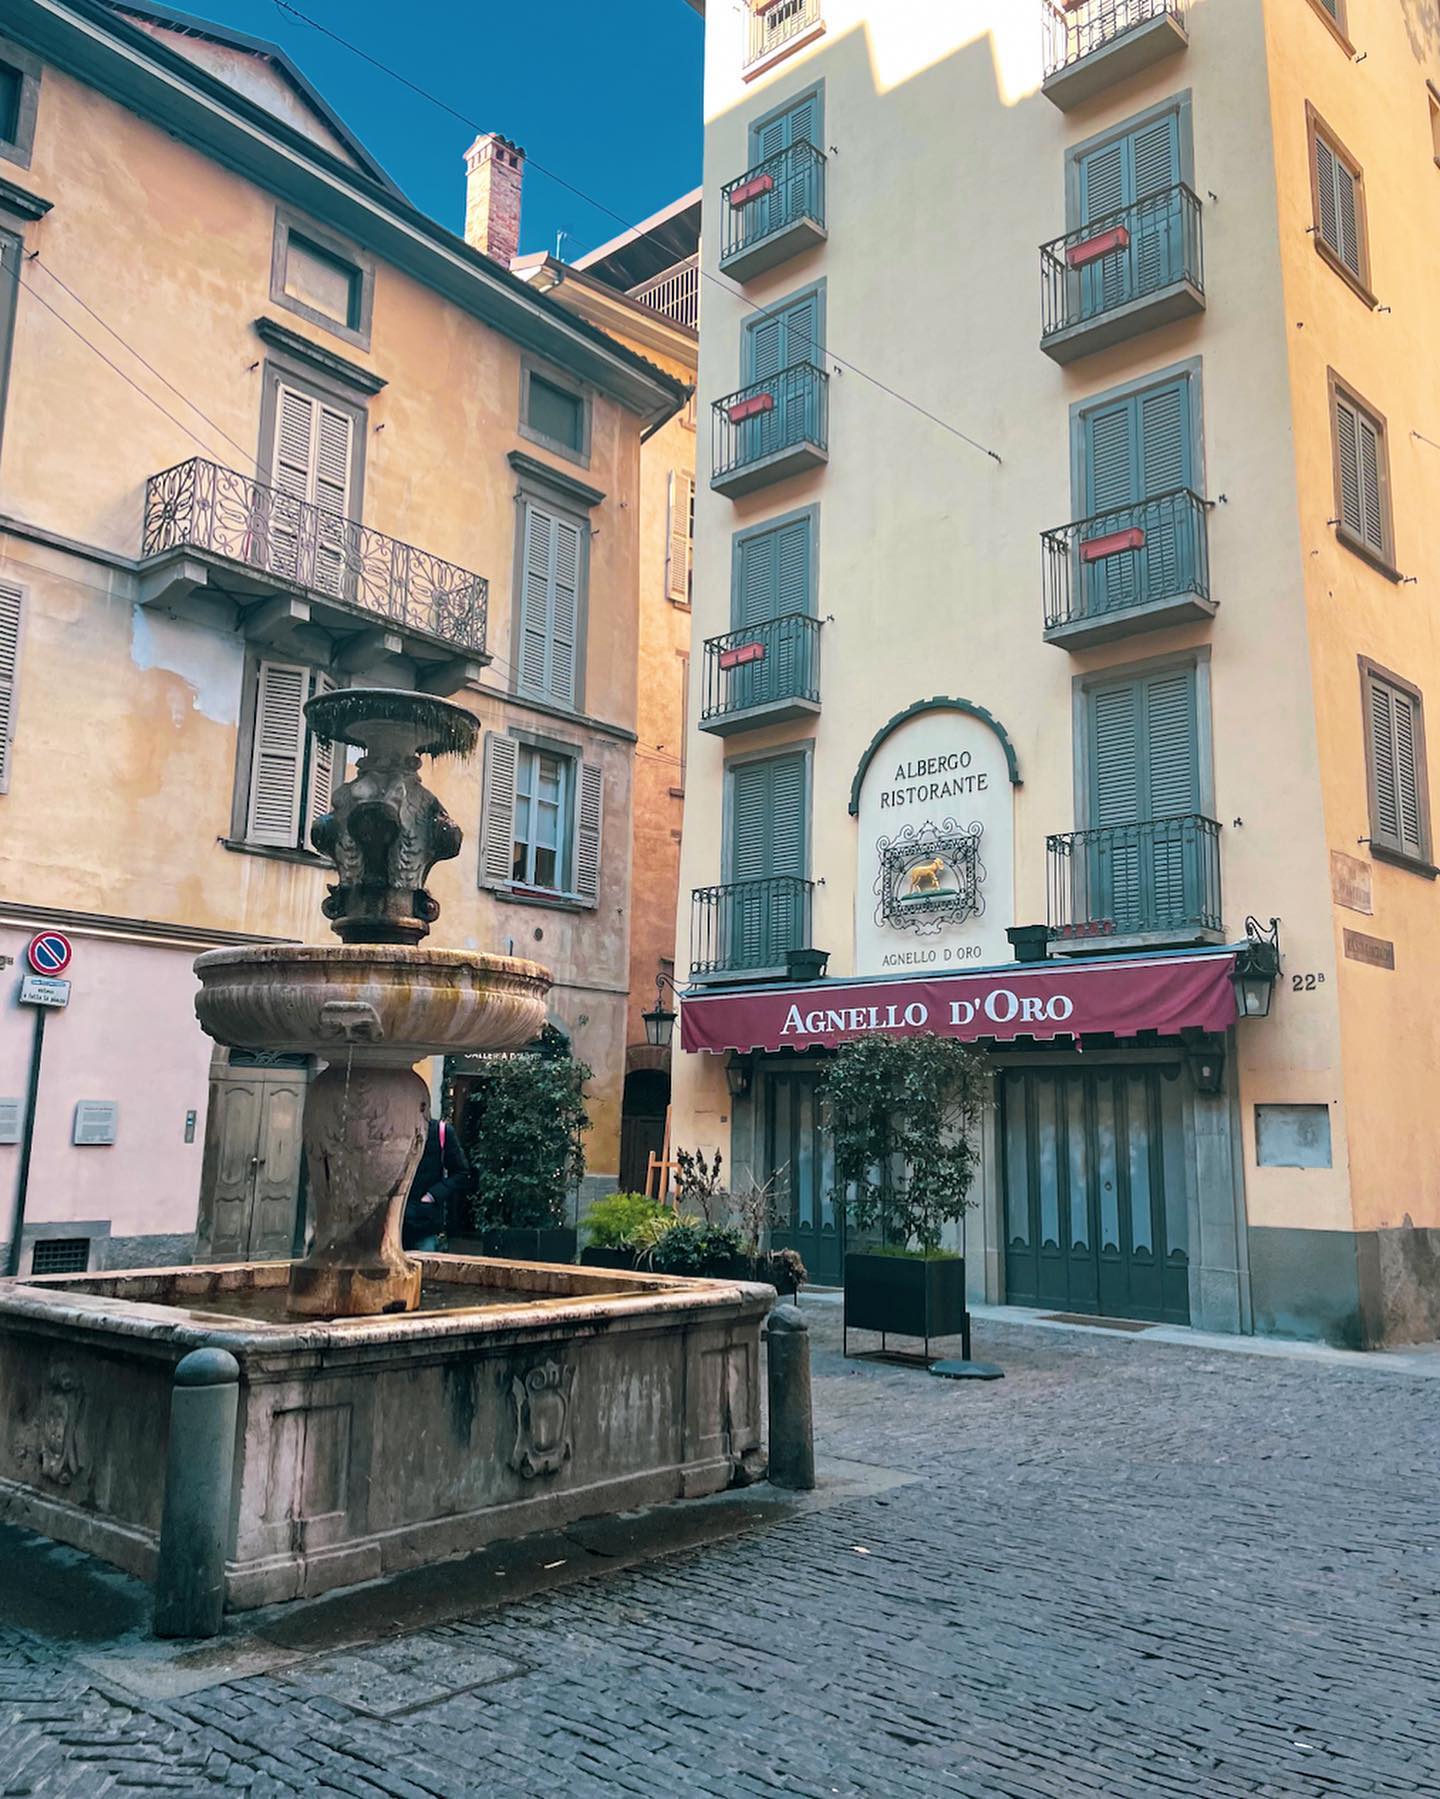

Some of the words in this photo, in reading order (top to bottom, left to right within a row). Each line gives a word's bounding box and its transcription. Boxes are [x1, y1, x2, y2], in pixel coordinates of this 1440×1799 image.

[894, 751, 972, 781] ALBERGO
[880, 774, 989, 809] RISTORANTE
[882, 950, 937, 967] AGNELLO
[957, 946, 982, 960] ORO
[780, 1003, 928, 1035] AGNELLO
[949, 989, 1074, 1025] D'ORO
